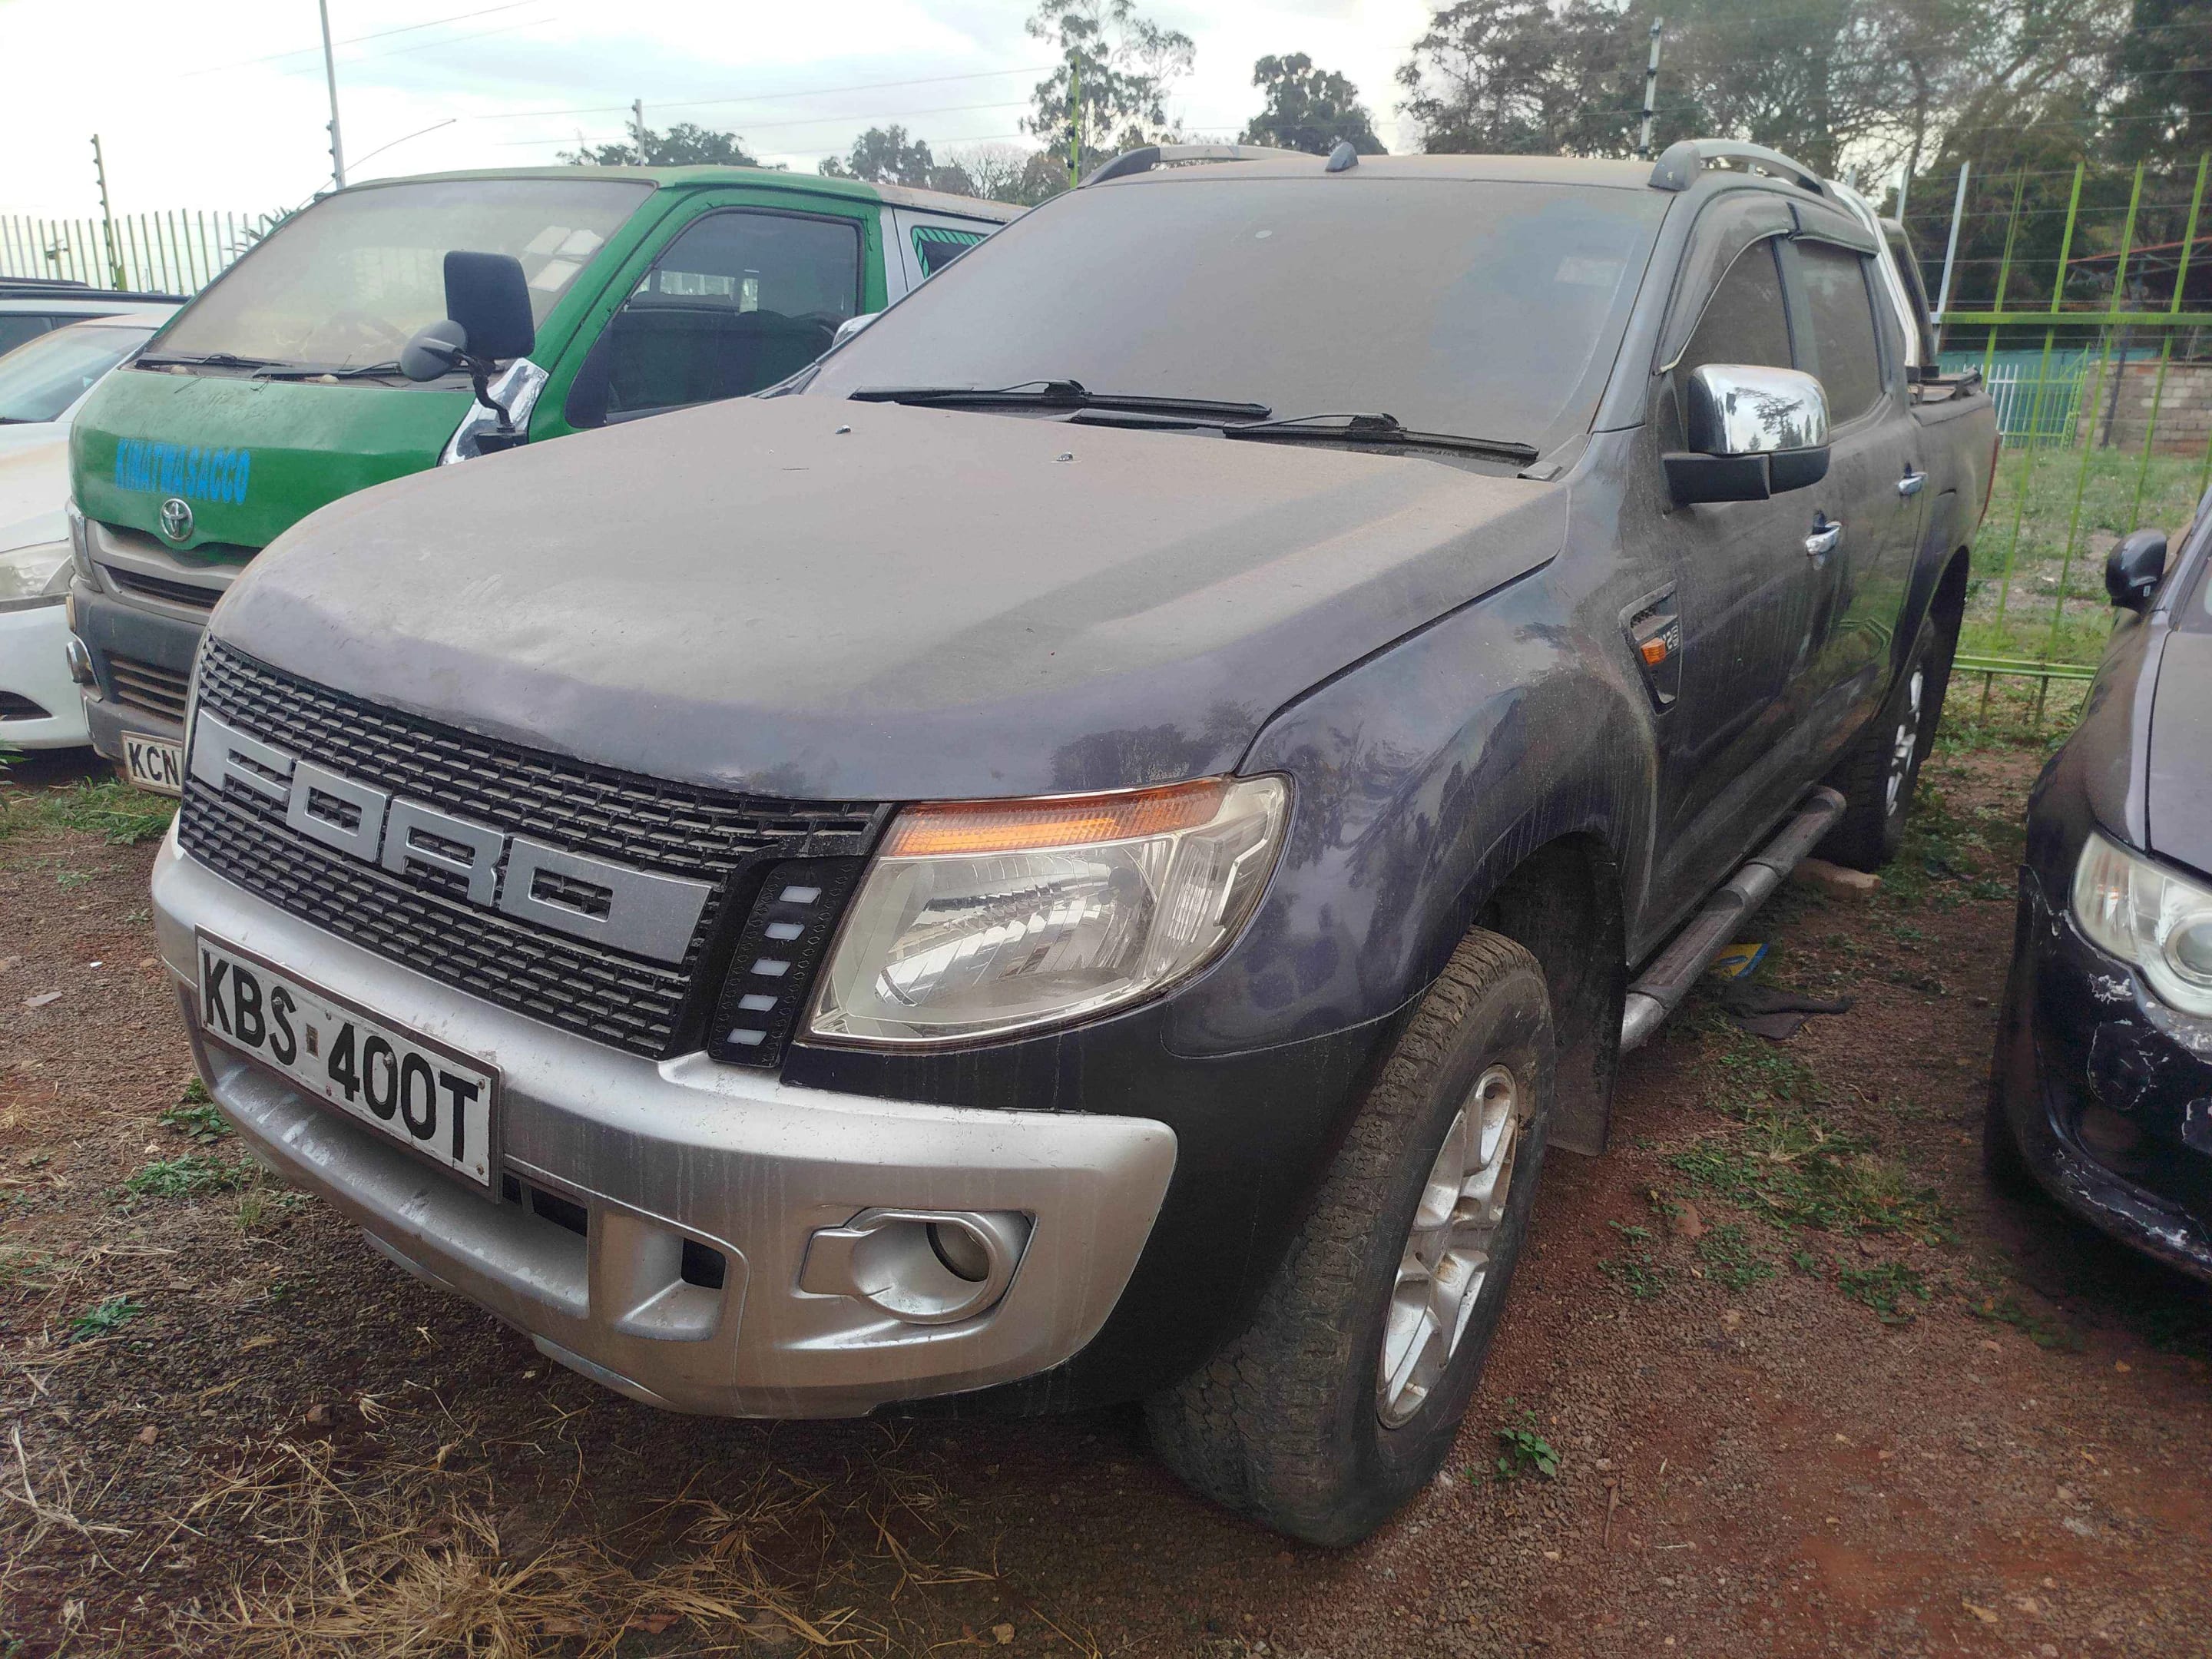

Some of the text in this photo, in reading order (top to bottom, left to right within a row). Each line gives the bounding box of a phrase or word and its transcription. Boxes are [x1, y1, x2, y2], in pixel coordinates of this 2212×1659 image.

[128, 742, 180, 786] KCN
[191, 707, 711, 964] FORD
[202, 949, 479, 1163] KBS 400T
